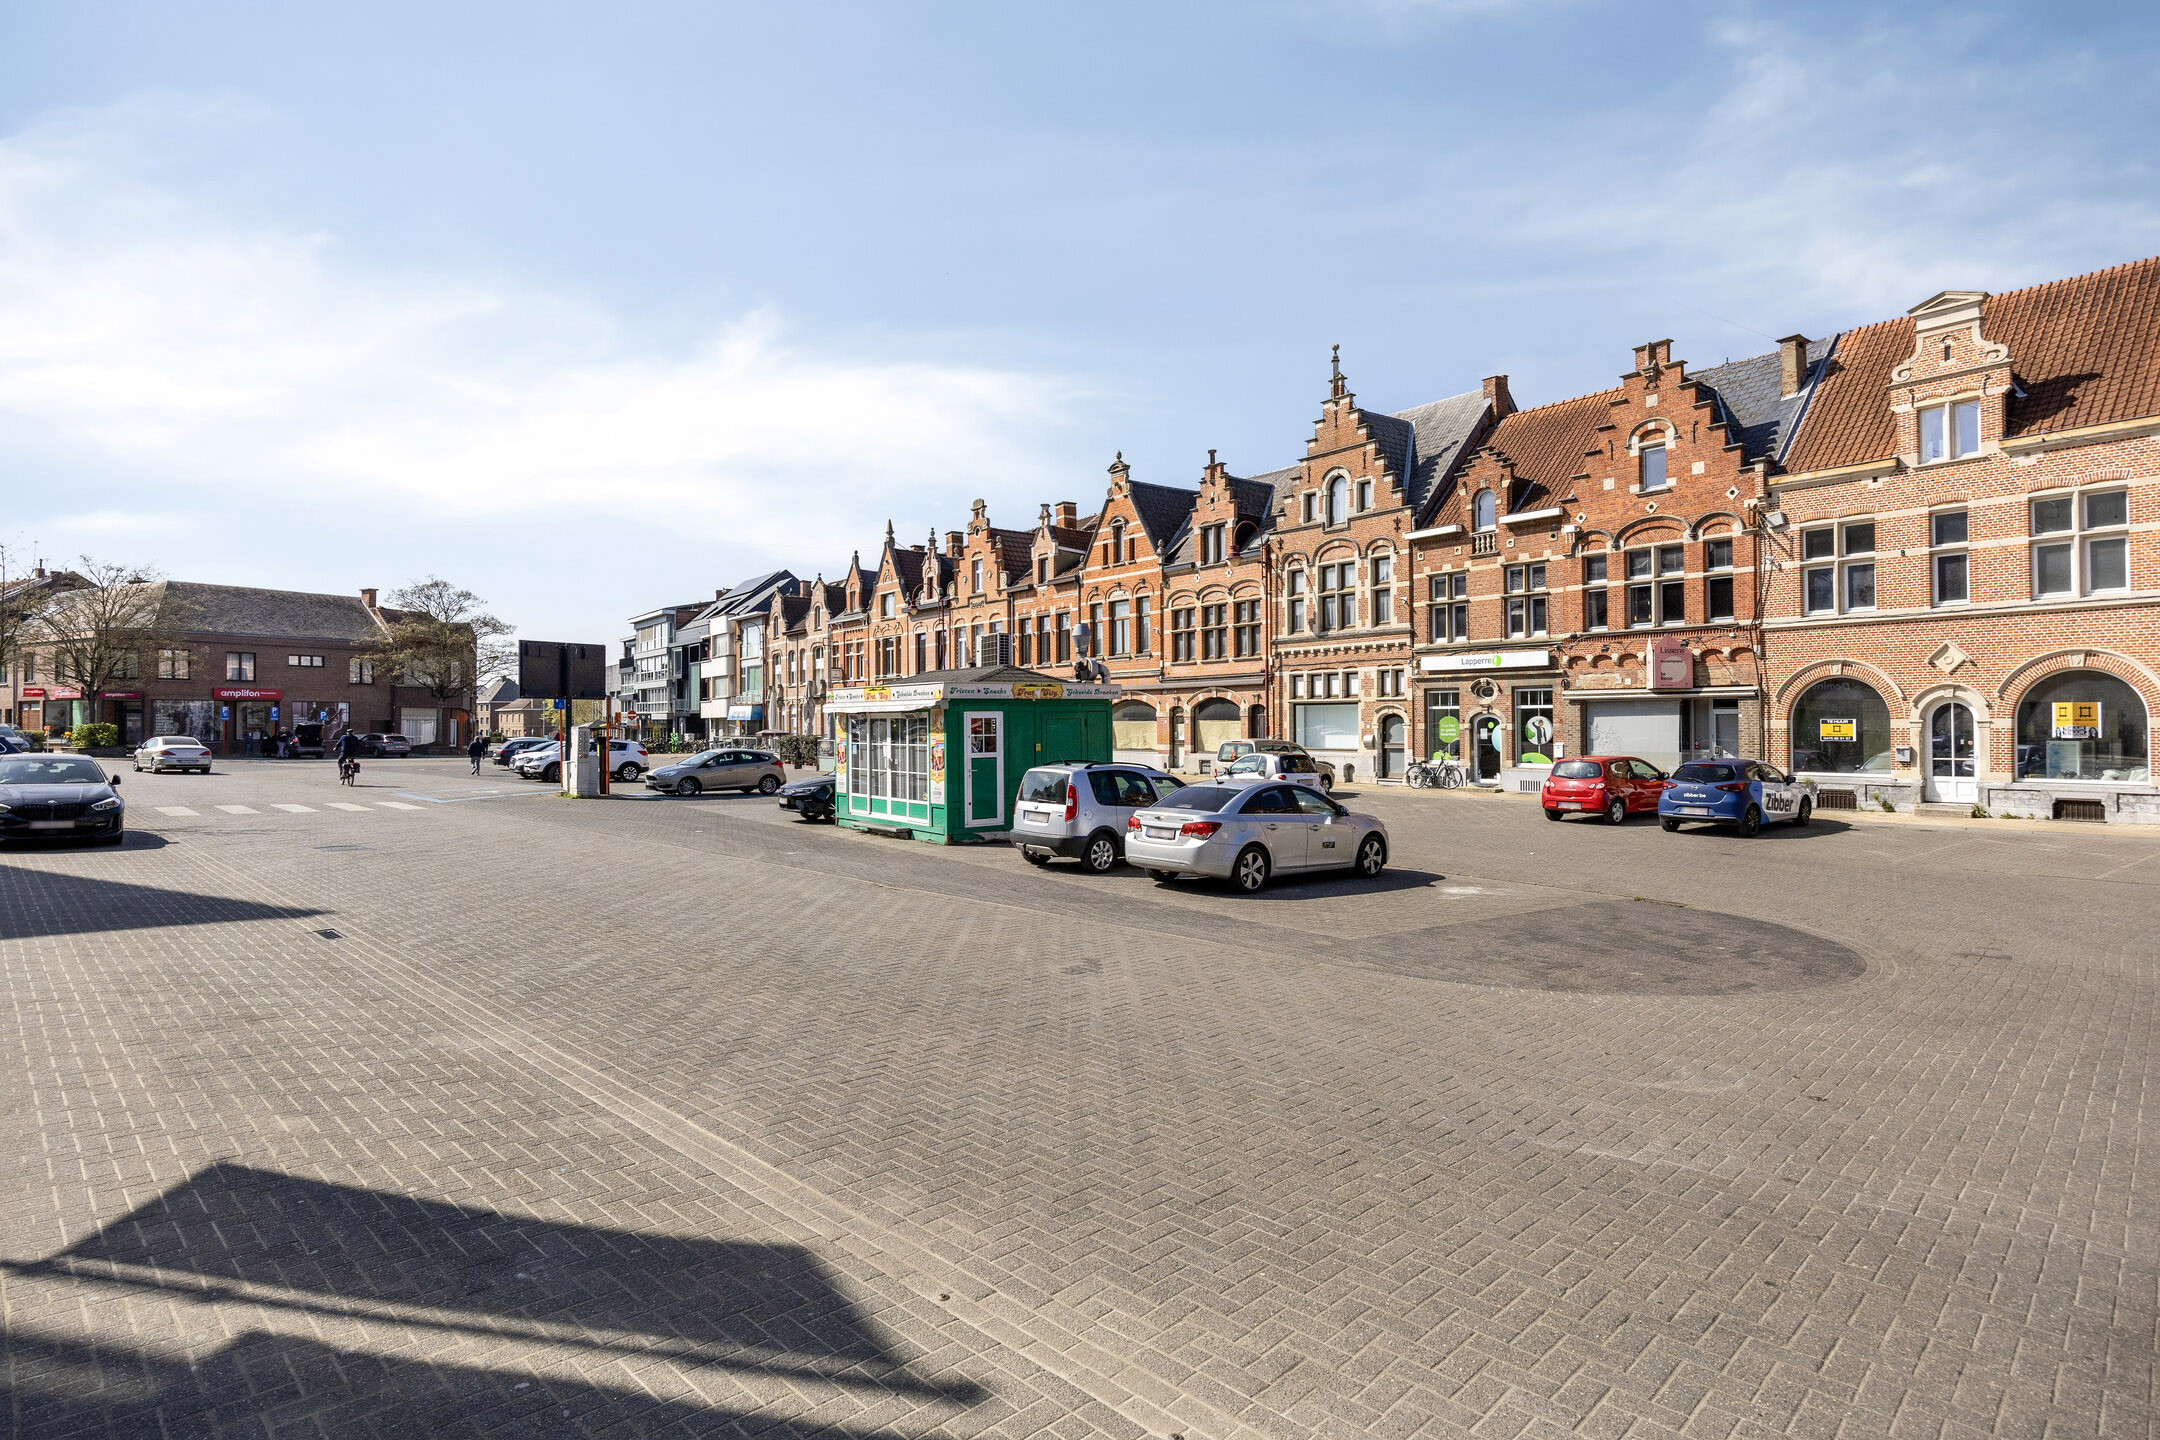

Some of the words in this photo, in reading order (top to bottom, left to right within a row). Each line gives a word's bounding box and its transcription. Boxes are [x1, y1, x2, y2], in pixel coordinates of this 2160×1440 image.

[1461, 657, 1492, 666] Lapperre
[220, 689, 260, 698] amplifon
[949, 687, 975, 695] Frieten
[983, 687, 1007, 695] Snacks
[320, 711, 327, 719] P
[1765, 792, 1794, 813] Zibber
